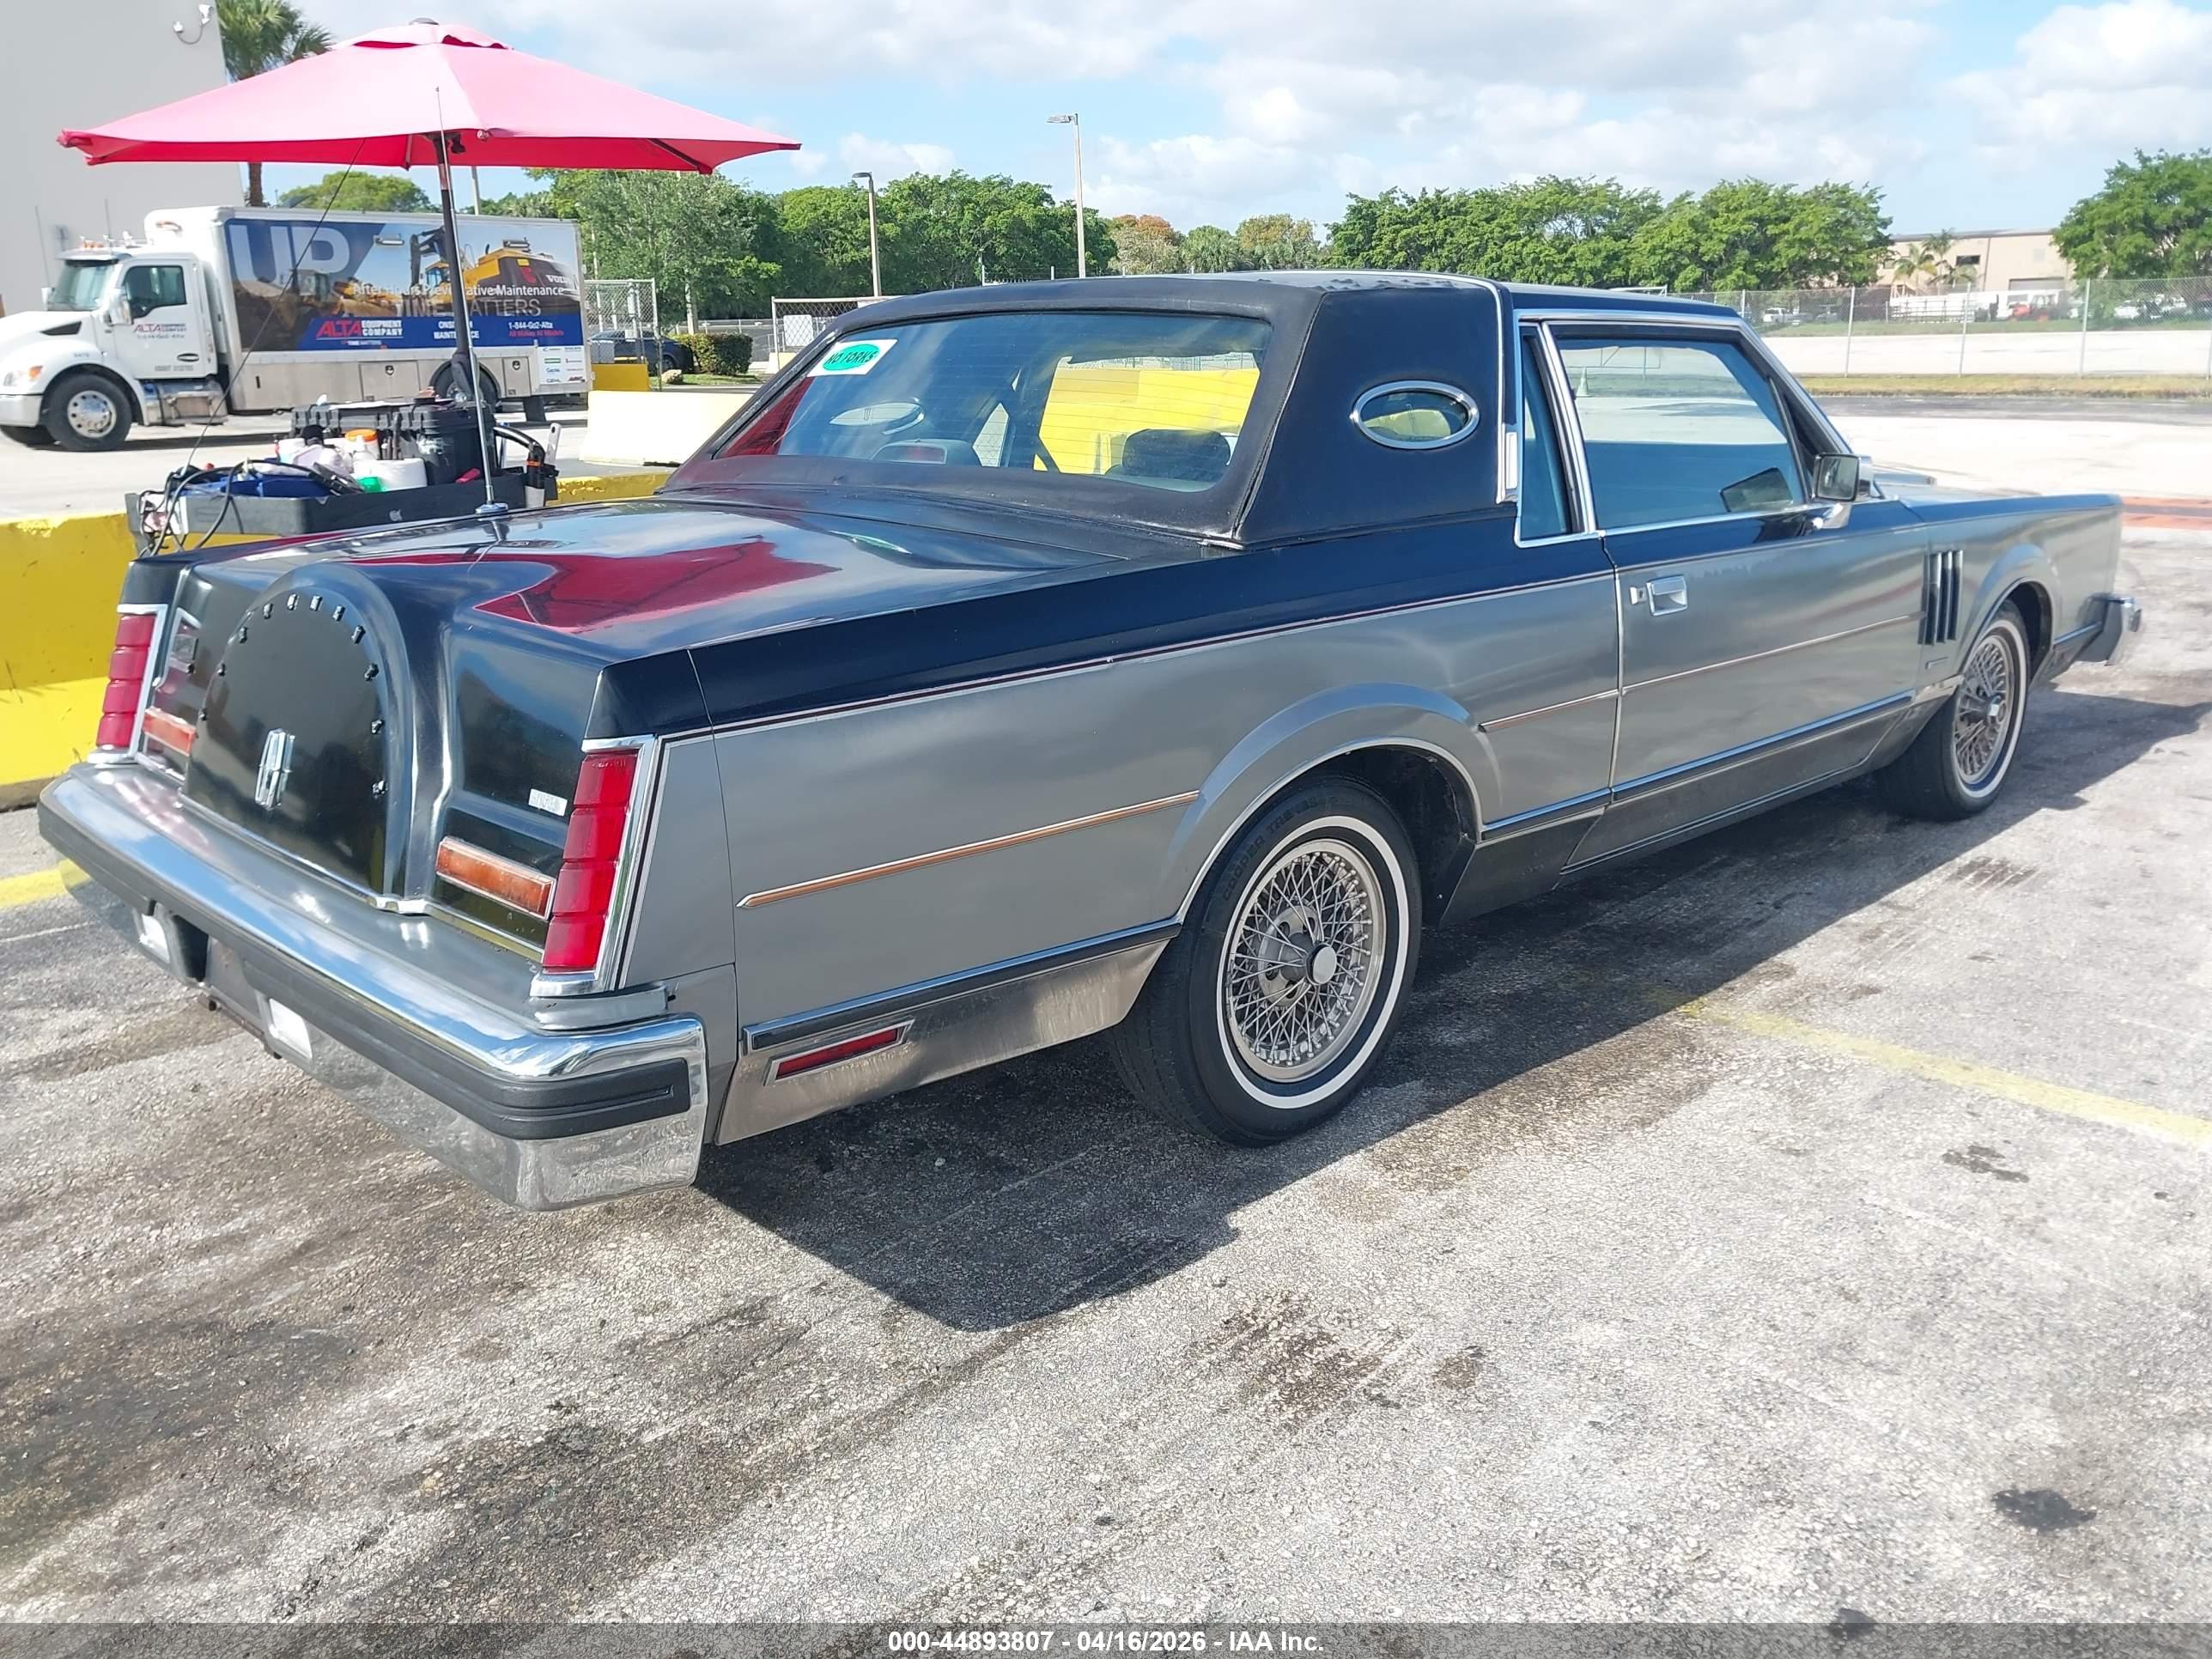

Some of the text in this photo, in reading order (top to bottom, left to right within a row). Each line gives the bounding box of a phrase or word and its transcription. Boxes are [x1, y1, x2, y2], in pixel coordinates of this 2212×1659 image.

[229, 225, 349, 297] UP
[496, 284, 563, 296] Maintenance
[469, 298, 541, 317] ATTERS
[316, 320, 362, 337] ALTA
[825, 350, 878, 365] NO FORKS
